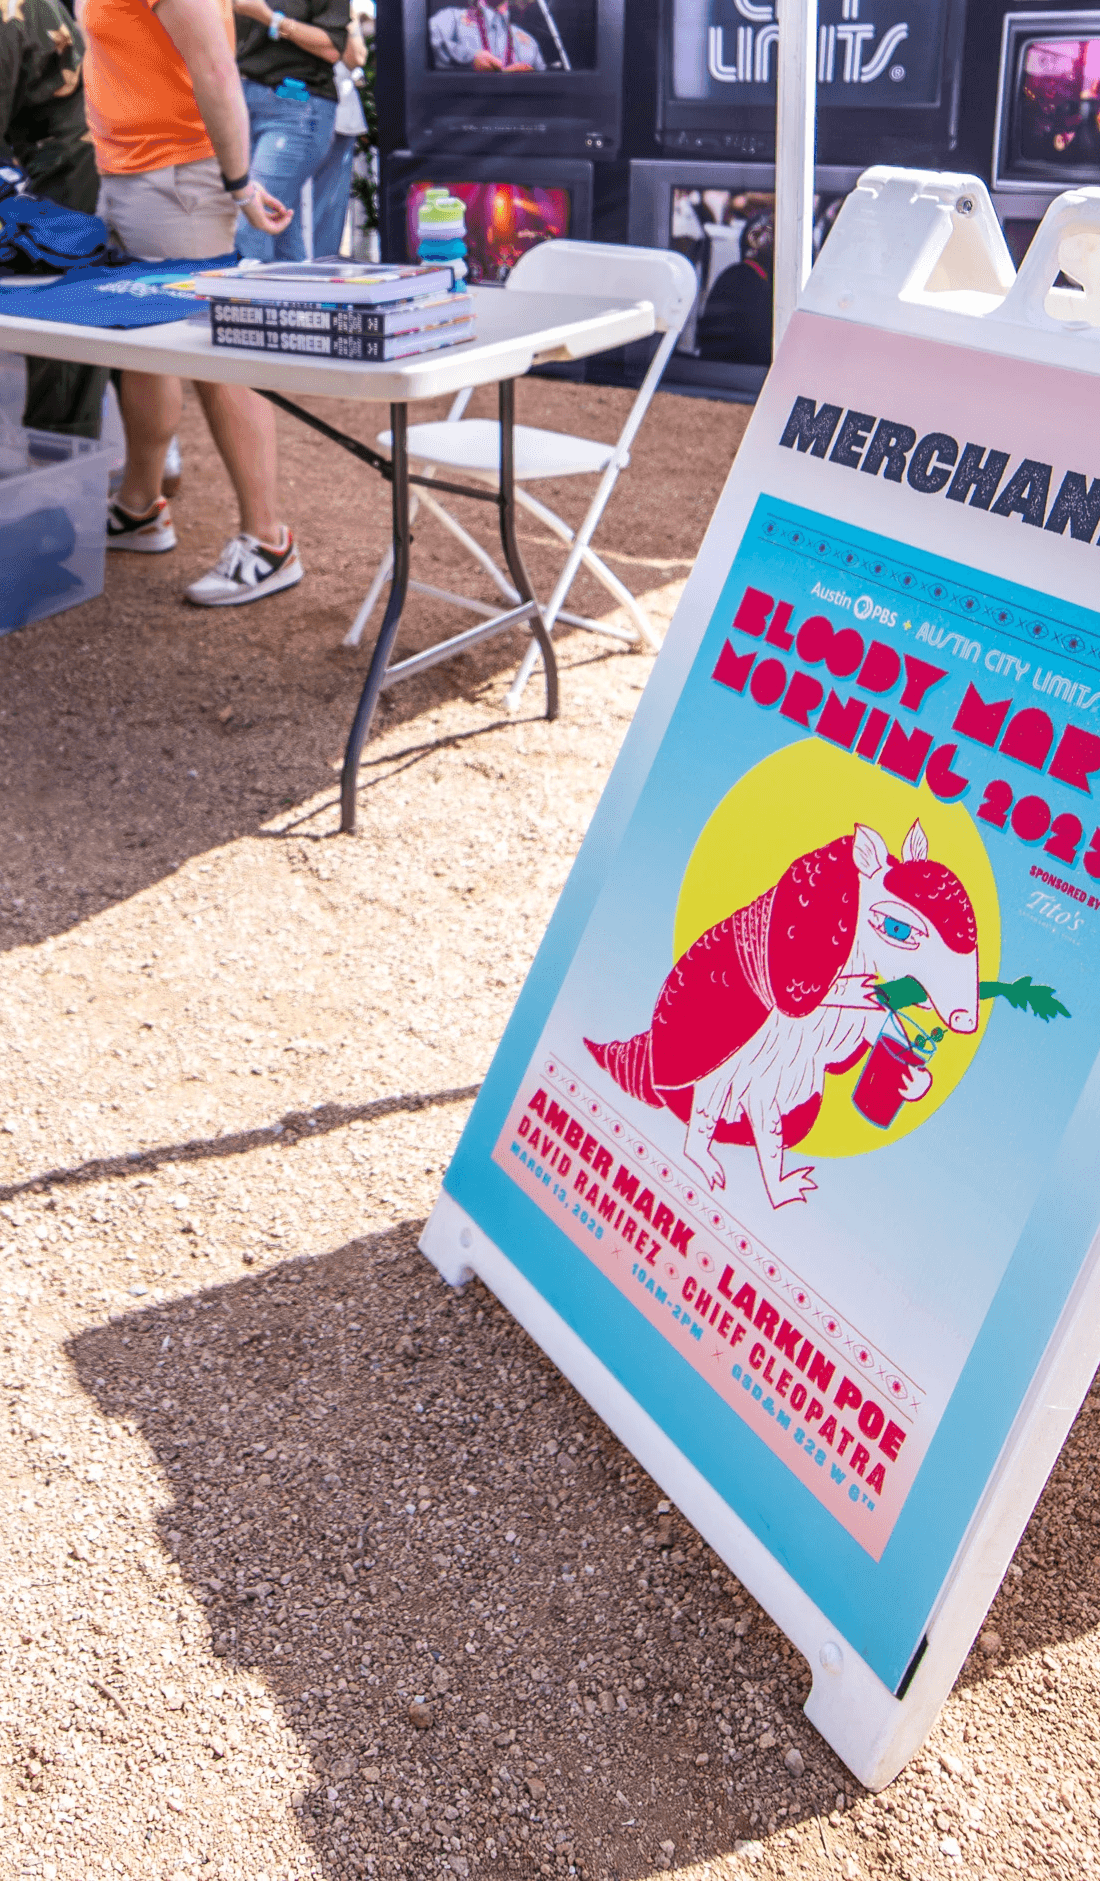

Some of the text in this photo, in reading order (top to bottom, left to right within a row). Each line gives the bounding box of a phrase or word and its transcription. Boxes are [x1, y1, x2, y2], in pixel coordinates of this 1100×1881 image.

[214, 304, 264, 325] SCREEN
[279, 309, 331, 330] SCREEN
[216, 327, 265, 347] SCREEN
[280, 332, 331, 354] SCREEN
[733, 586, 949, 711] BLOODY
[811, 581, 852, 610] Austin
[871, 605, 898, 628] PBS
[915, 621, 982, 663] AUSTIN
[985, 649, 1031, 682] CITY
[711, 638, 969, 799] MORNING
[1026, 891, 1085, 931] Tito's
[1029, 864, 1088, 903] SPONSORED
[510, 1141, 552, 1187] MARCH
[571, 1203, 604, 1240] 2025
[631, 1263, 704, 1341] 10AM-2PM
[731, 1363, 792, 1431] GSD&M
[793, 1427, 827, 1467] 828
[830, 1462, 847, 1486] W
[517, 1115, 886, 1496] DAVID RAMIREZ CHIEF CLEOPATRA
[528, 1088, 907, 1462] AMBER MARK LARKIN POE
